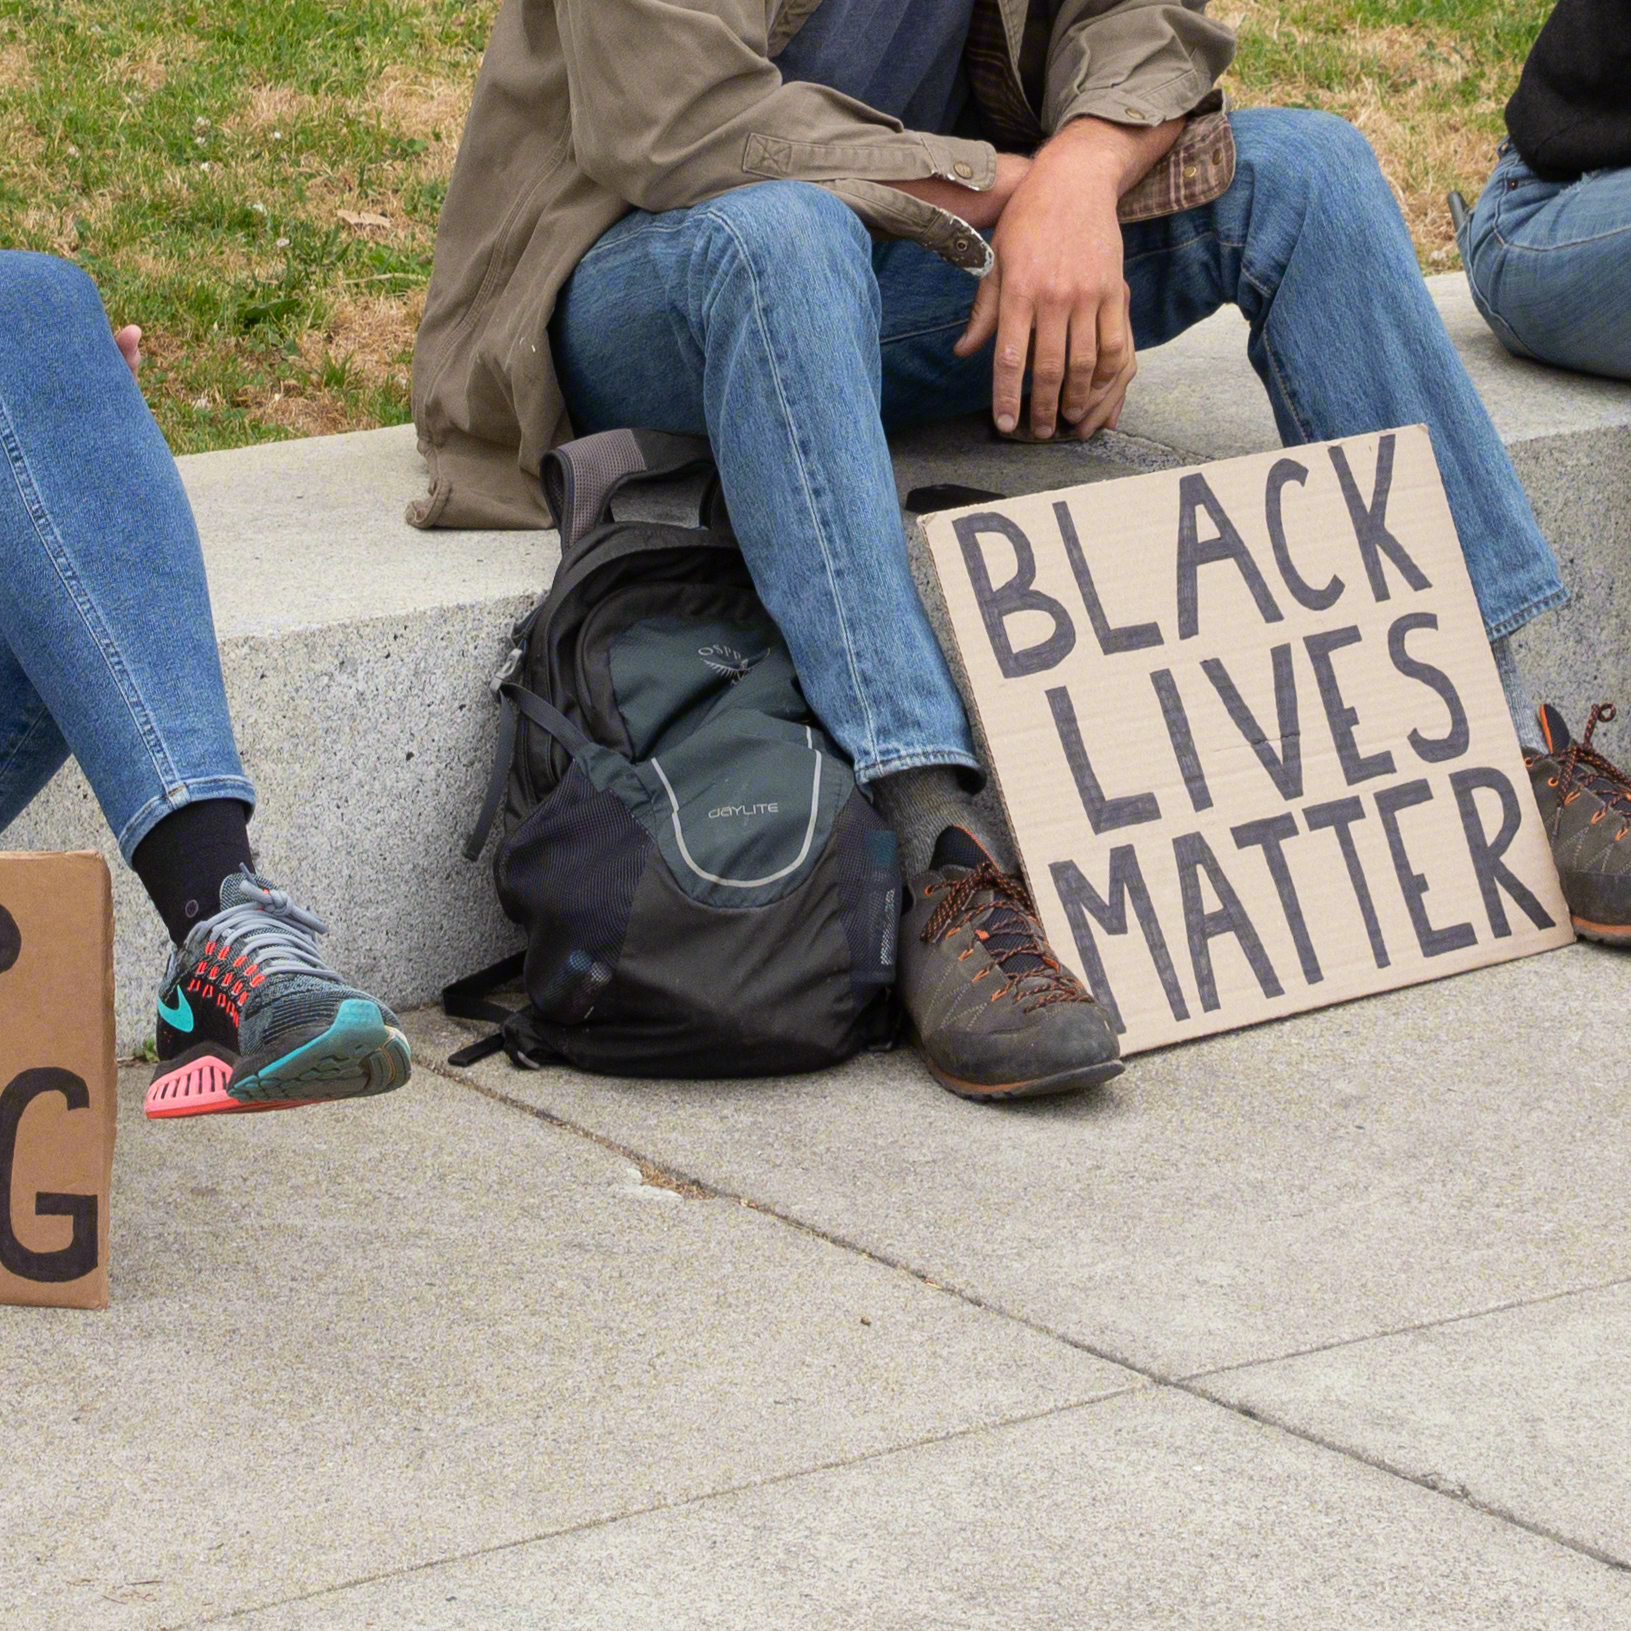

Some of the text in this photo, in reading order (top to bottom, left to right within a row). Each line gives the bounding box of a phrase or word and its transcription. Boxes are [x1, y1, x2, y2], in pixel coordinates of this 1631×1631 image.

[952, 434, 1432, 679] BLACK
[1045, 612, 1470, 835] LIVES
[1048, 766, 1556, 1035] MATTER
